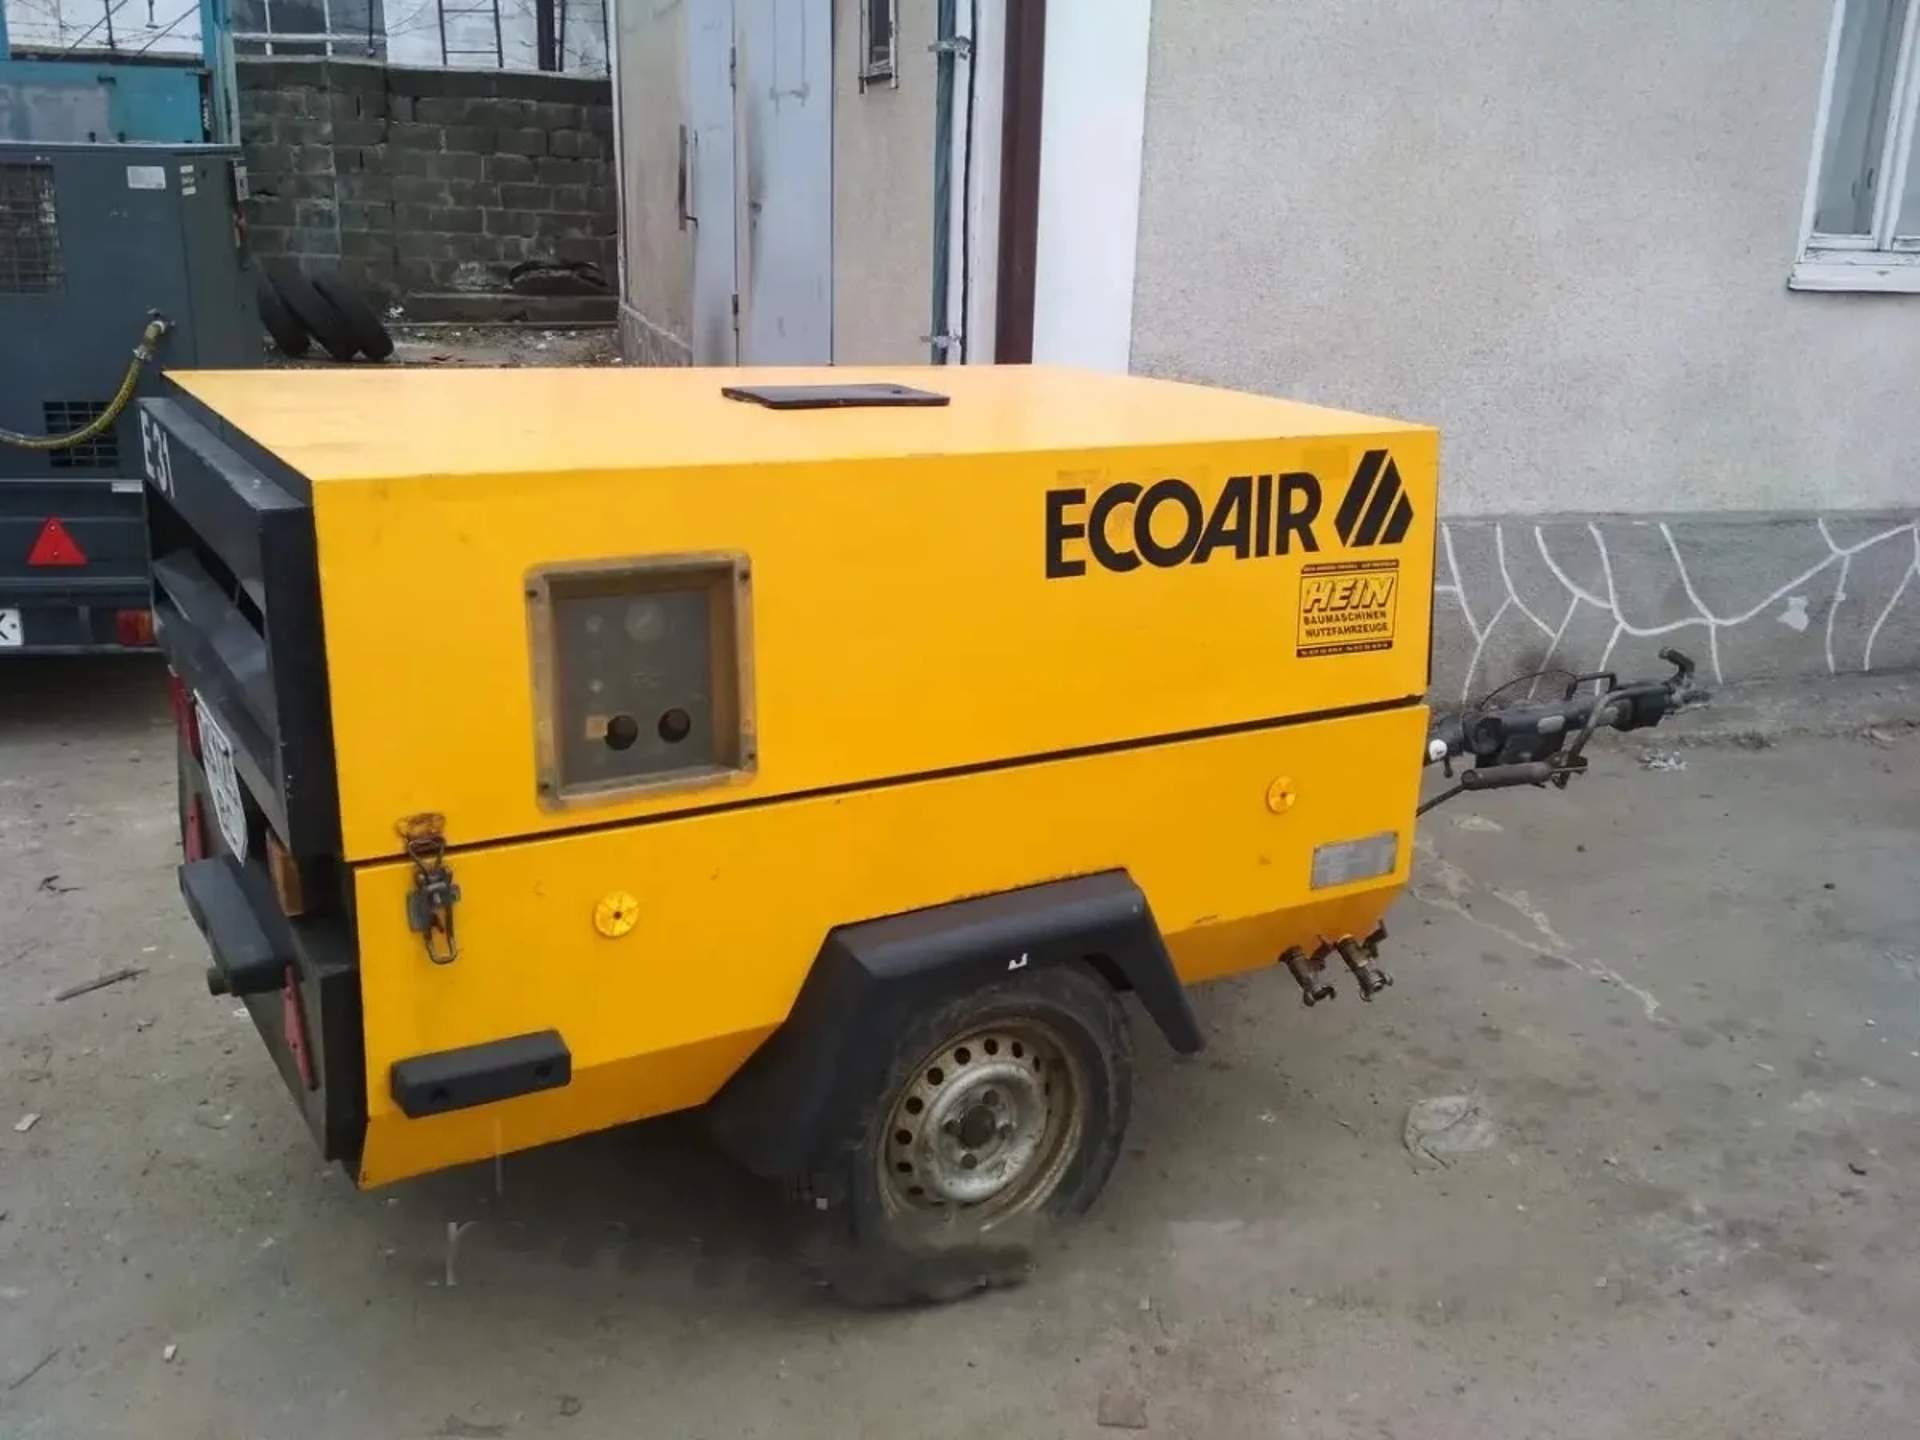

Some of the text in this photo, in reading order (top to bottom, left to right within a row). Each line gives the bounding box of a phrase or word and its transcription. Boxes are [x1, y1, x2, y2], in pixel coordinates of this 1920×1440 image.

[1045, 471, 1321, 579] ECOAIR
[1302, 576, 1394, 613] HEIN
[1303, 611, 1387, 625] BAUMASCHINEN
[1305, 622, 1388, 638] NUTZFAHRZEUGE
